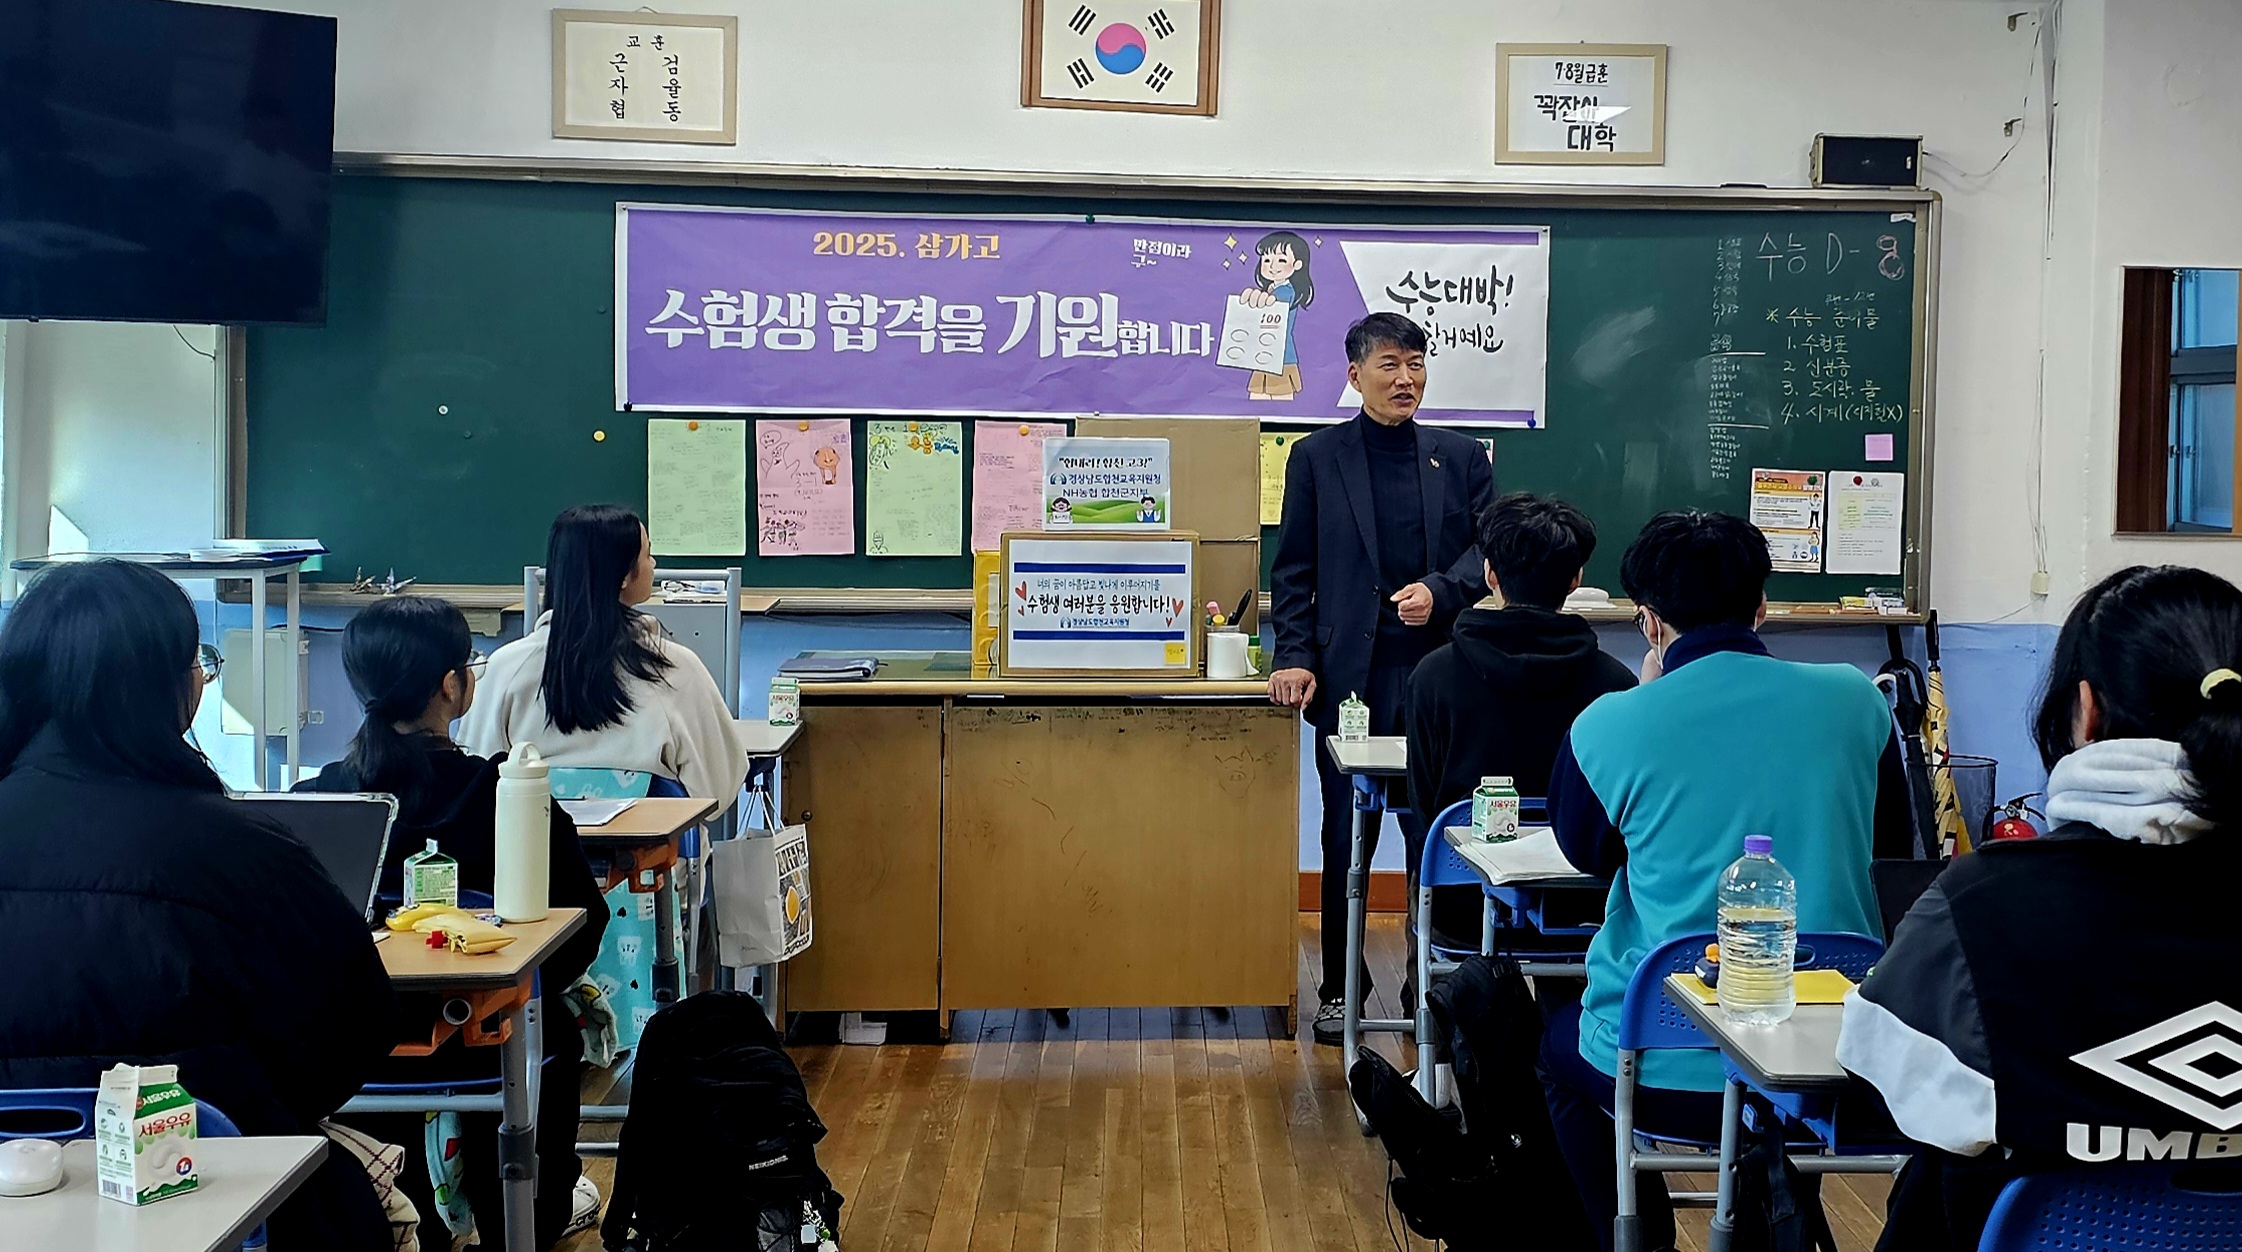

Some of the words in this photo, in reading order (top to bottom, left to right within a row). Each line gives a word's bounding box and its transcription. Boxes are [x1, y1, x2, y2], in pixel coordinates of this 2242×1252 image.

[1567, 122, 1617, 152] 대학
[813, 231, 905, 258] 2025.
[915, 231, 1001, 261] 삼가고
[1132, 237, 1192, 260] 만점이라
[1756, 231, 1807, 282] 수능
[1385, 264, 1514, 316] 수능대박!
[645, 289, 817, 351] 수험생
[825, 292, 988, 354] 합격을
[996, 290, 1216, 359] 기원합니다
[1260, 312, 1282, 325] 100
[1801, 333, 1848, 355] 수험표
[1806, 357, 1852, 377] 신분증
[1027, 594, 1060, 615] 수험생
[1063, 594, 1107, 616] 여러분을
[1109, 594, 1171, 615] 응원합니다!
[142, 1088, 181, 1106] 서울우유
[139, 1111, 192, 1138] 서울우유
[2066, 1122, 2242, 1162] UMB
